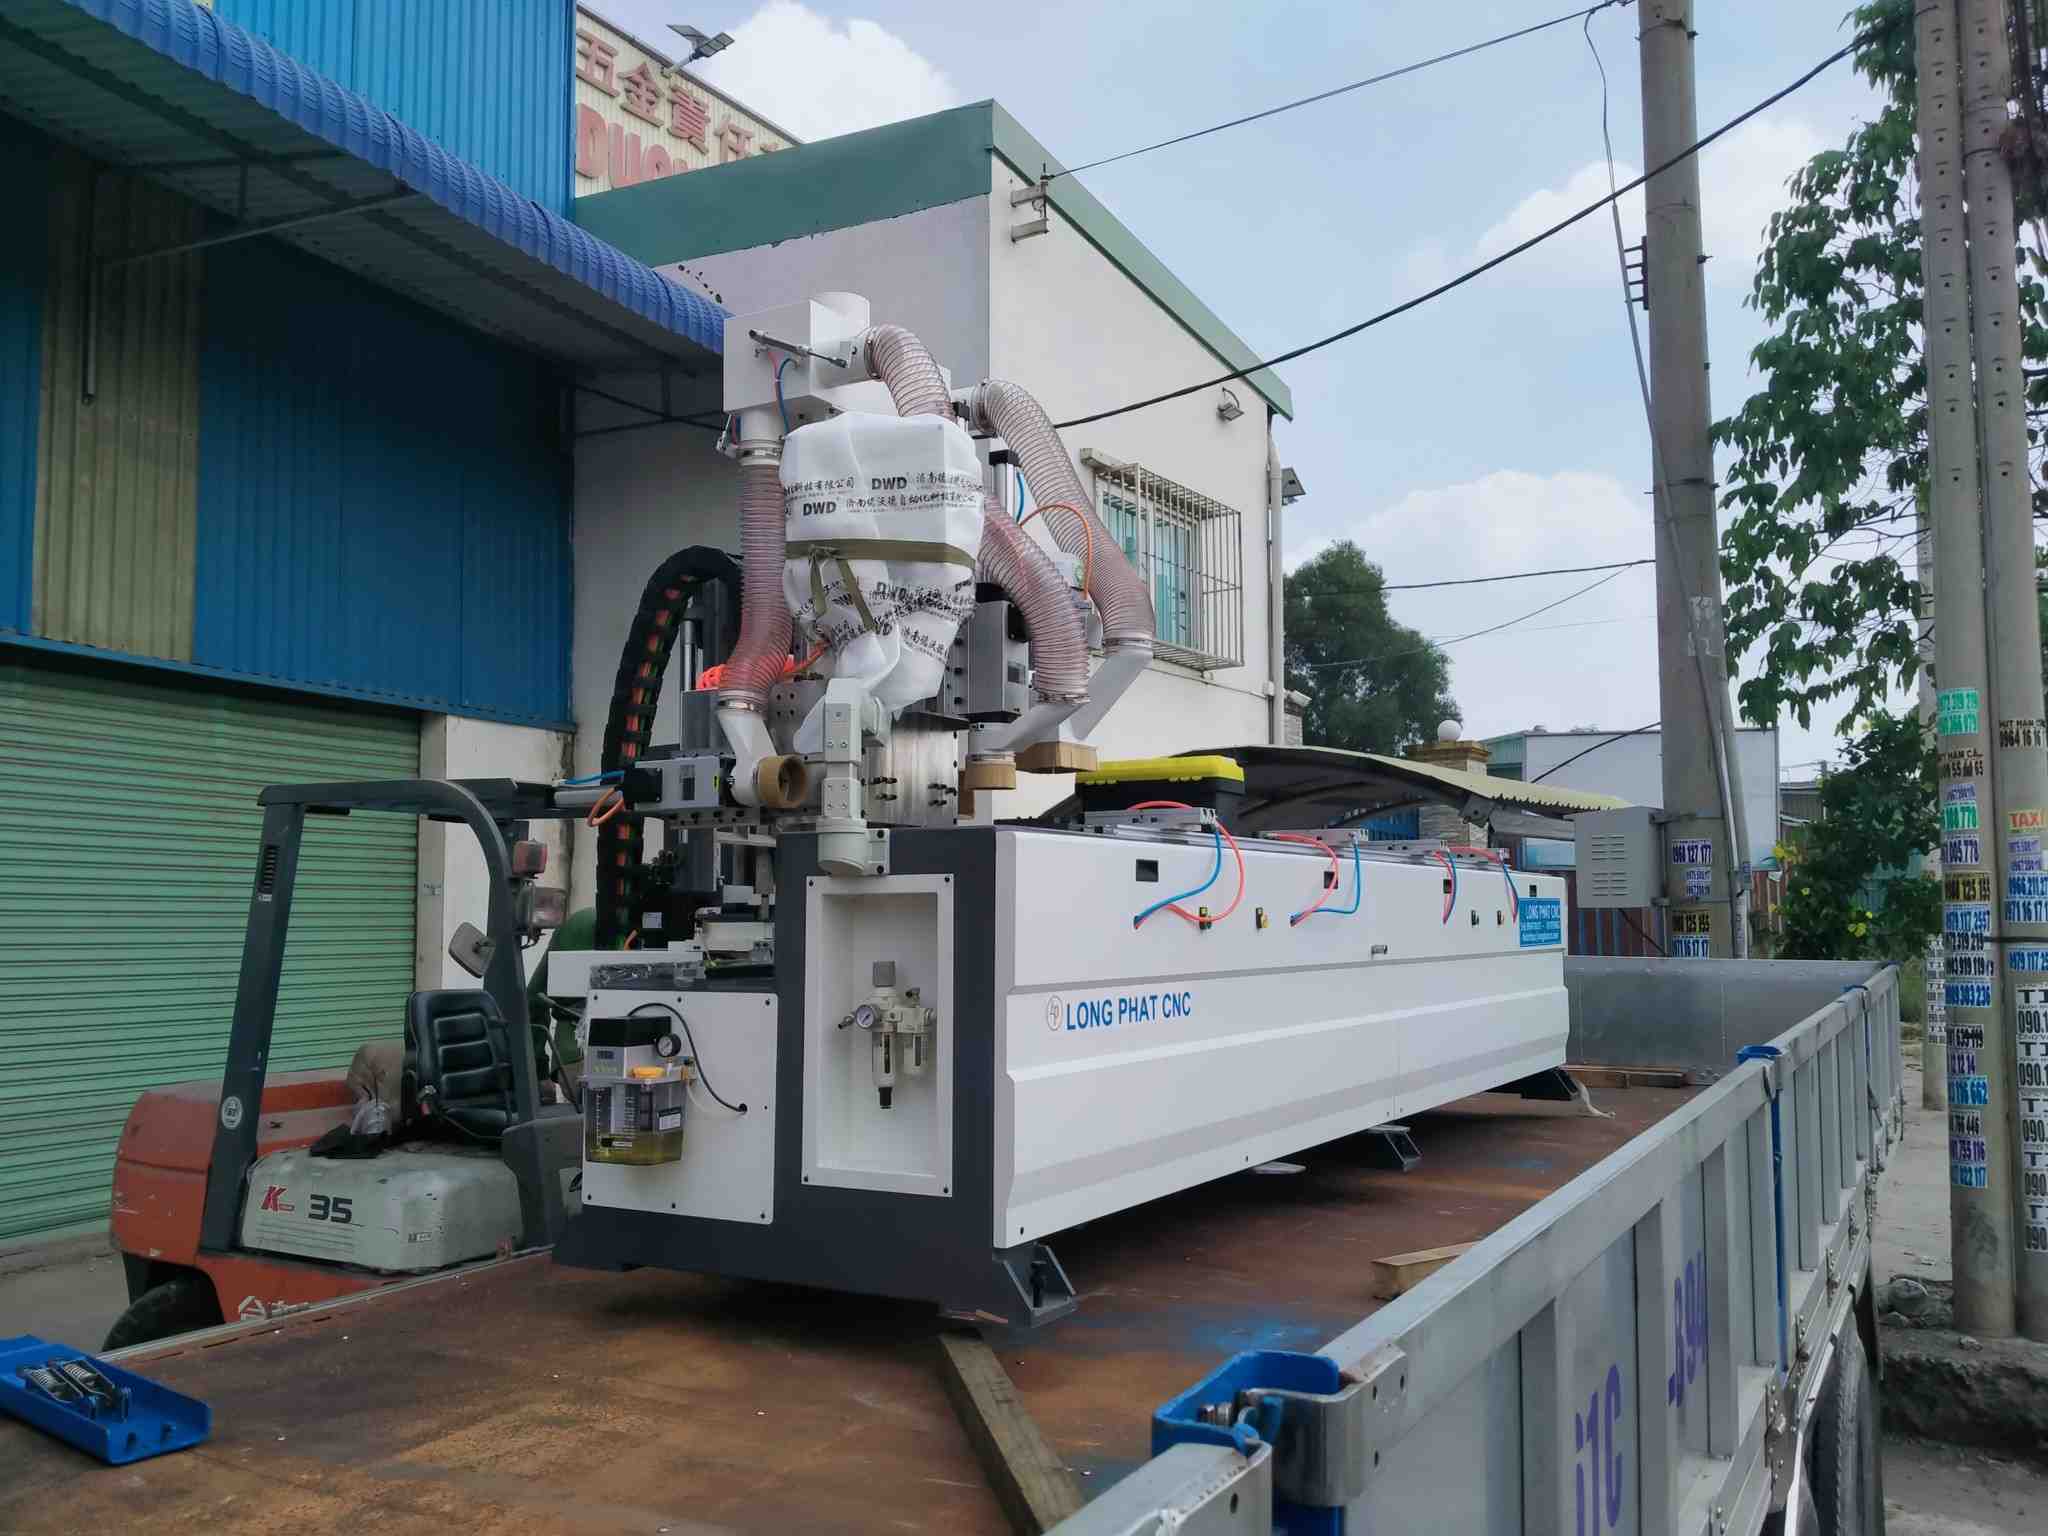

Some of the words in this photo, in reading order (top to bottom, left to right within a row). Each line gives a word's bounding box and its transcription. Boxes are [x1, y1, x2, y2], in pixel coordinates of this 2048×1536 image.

[871, 476, 908, 491] DWD
[802, 501, 837, 516] DWD
[1066, 999, 1112, 1030] LONG
[1119, 995, 1158, 1024] PHAT
[1162, 991, 1192, 1018] CNC
[308, 1194, 353, 1224] 35
